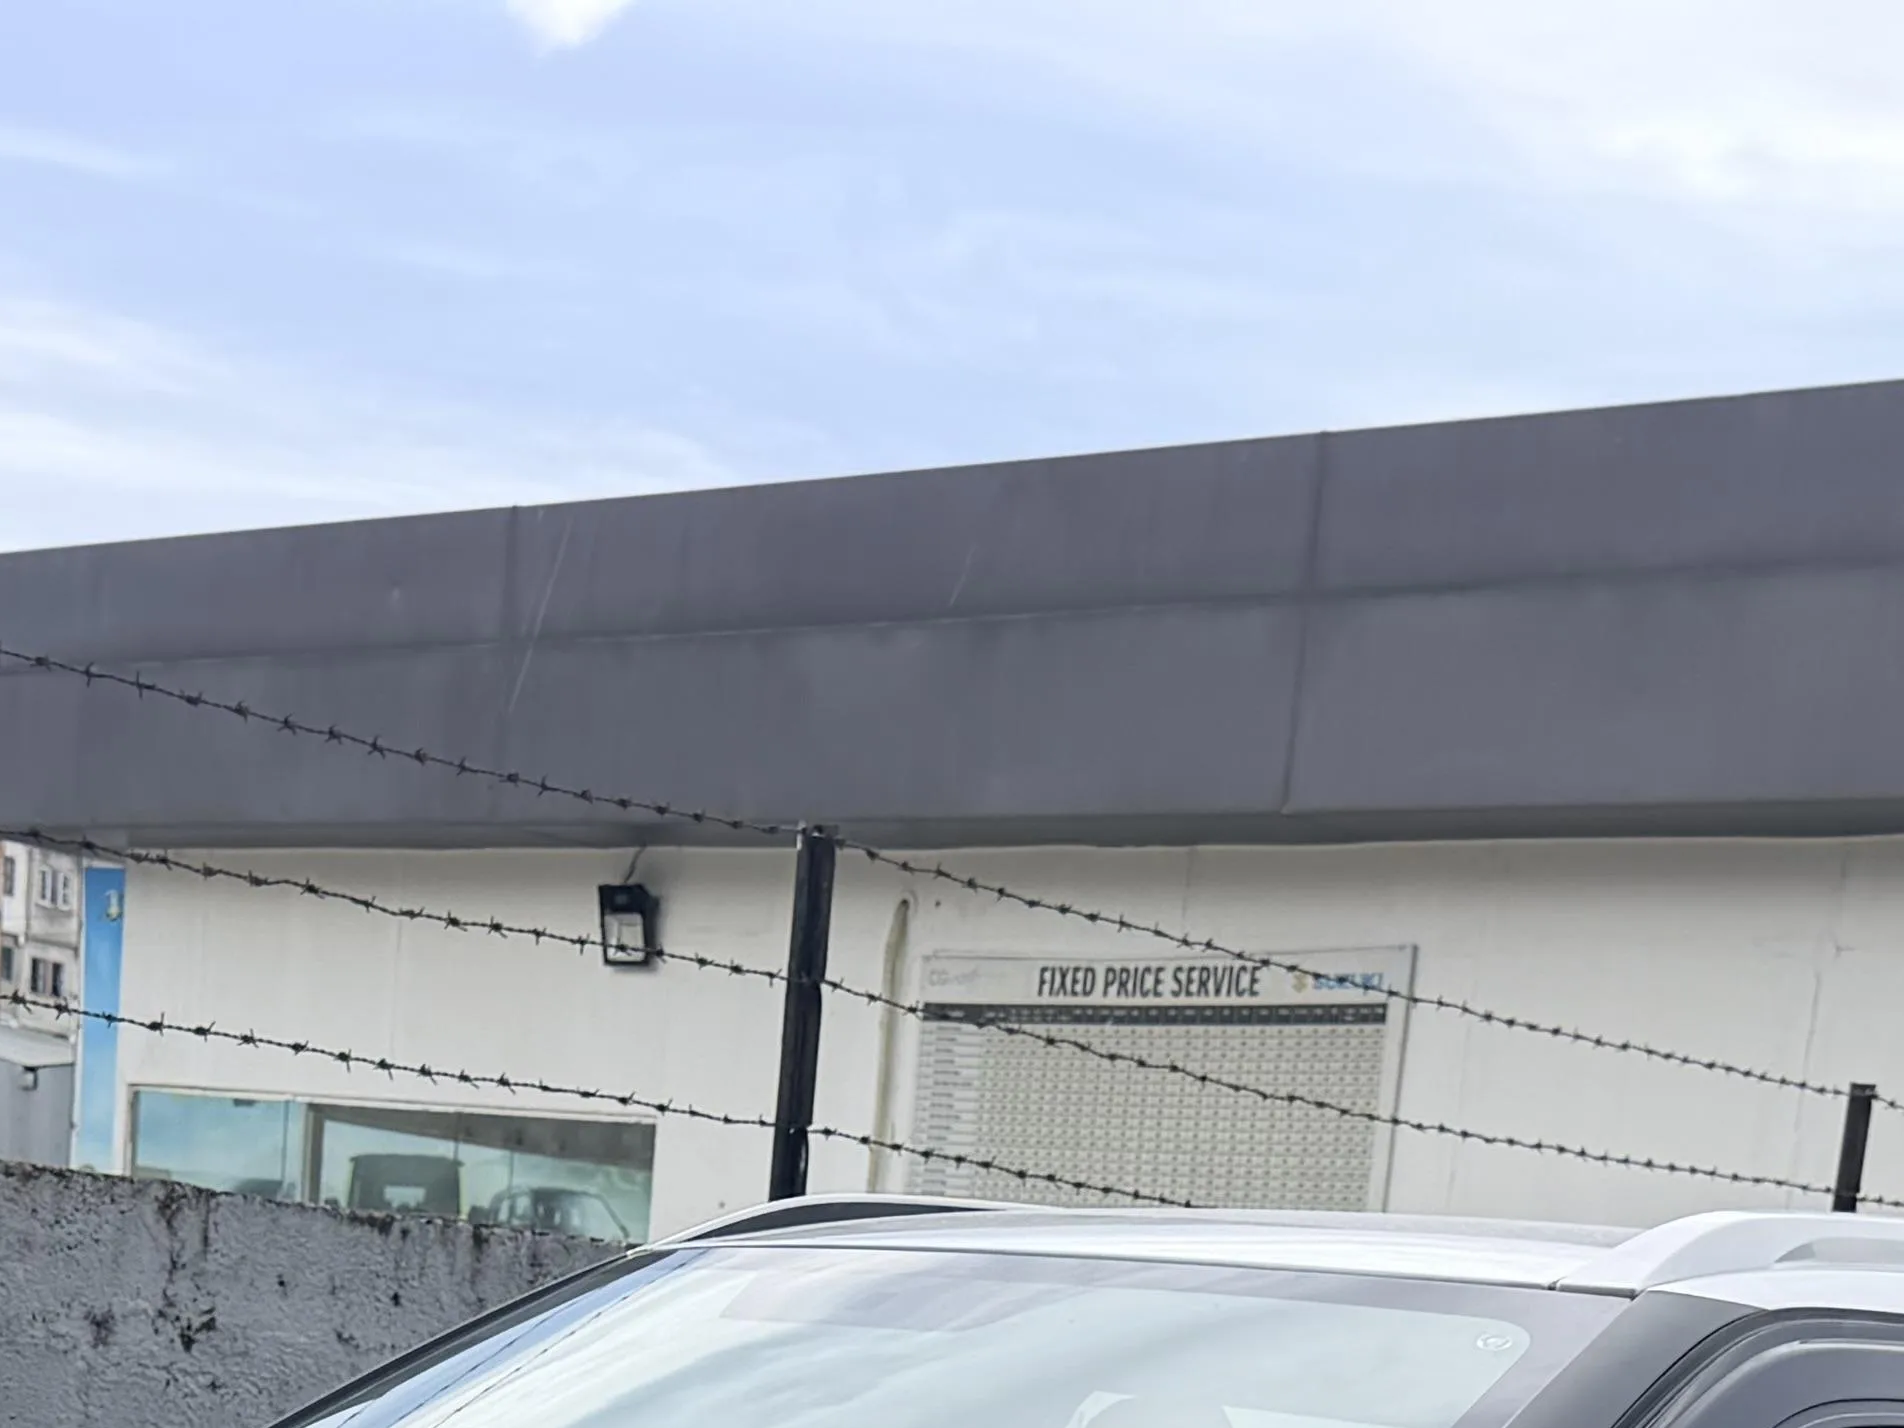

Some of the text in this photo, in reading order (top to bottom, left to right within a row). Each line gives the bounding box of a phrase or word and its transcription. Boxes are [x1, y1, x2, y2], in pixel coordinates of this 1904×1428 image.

[1037, 964, 1263, 998] FIXED PRICE SERVICE
